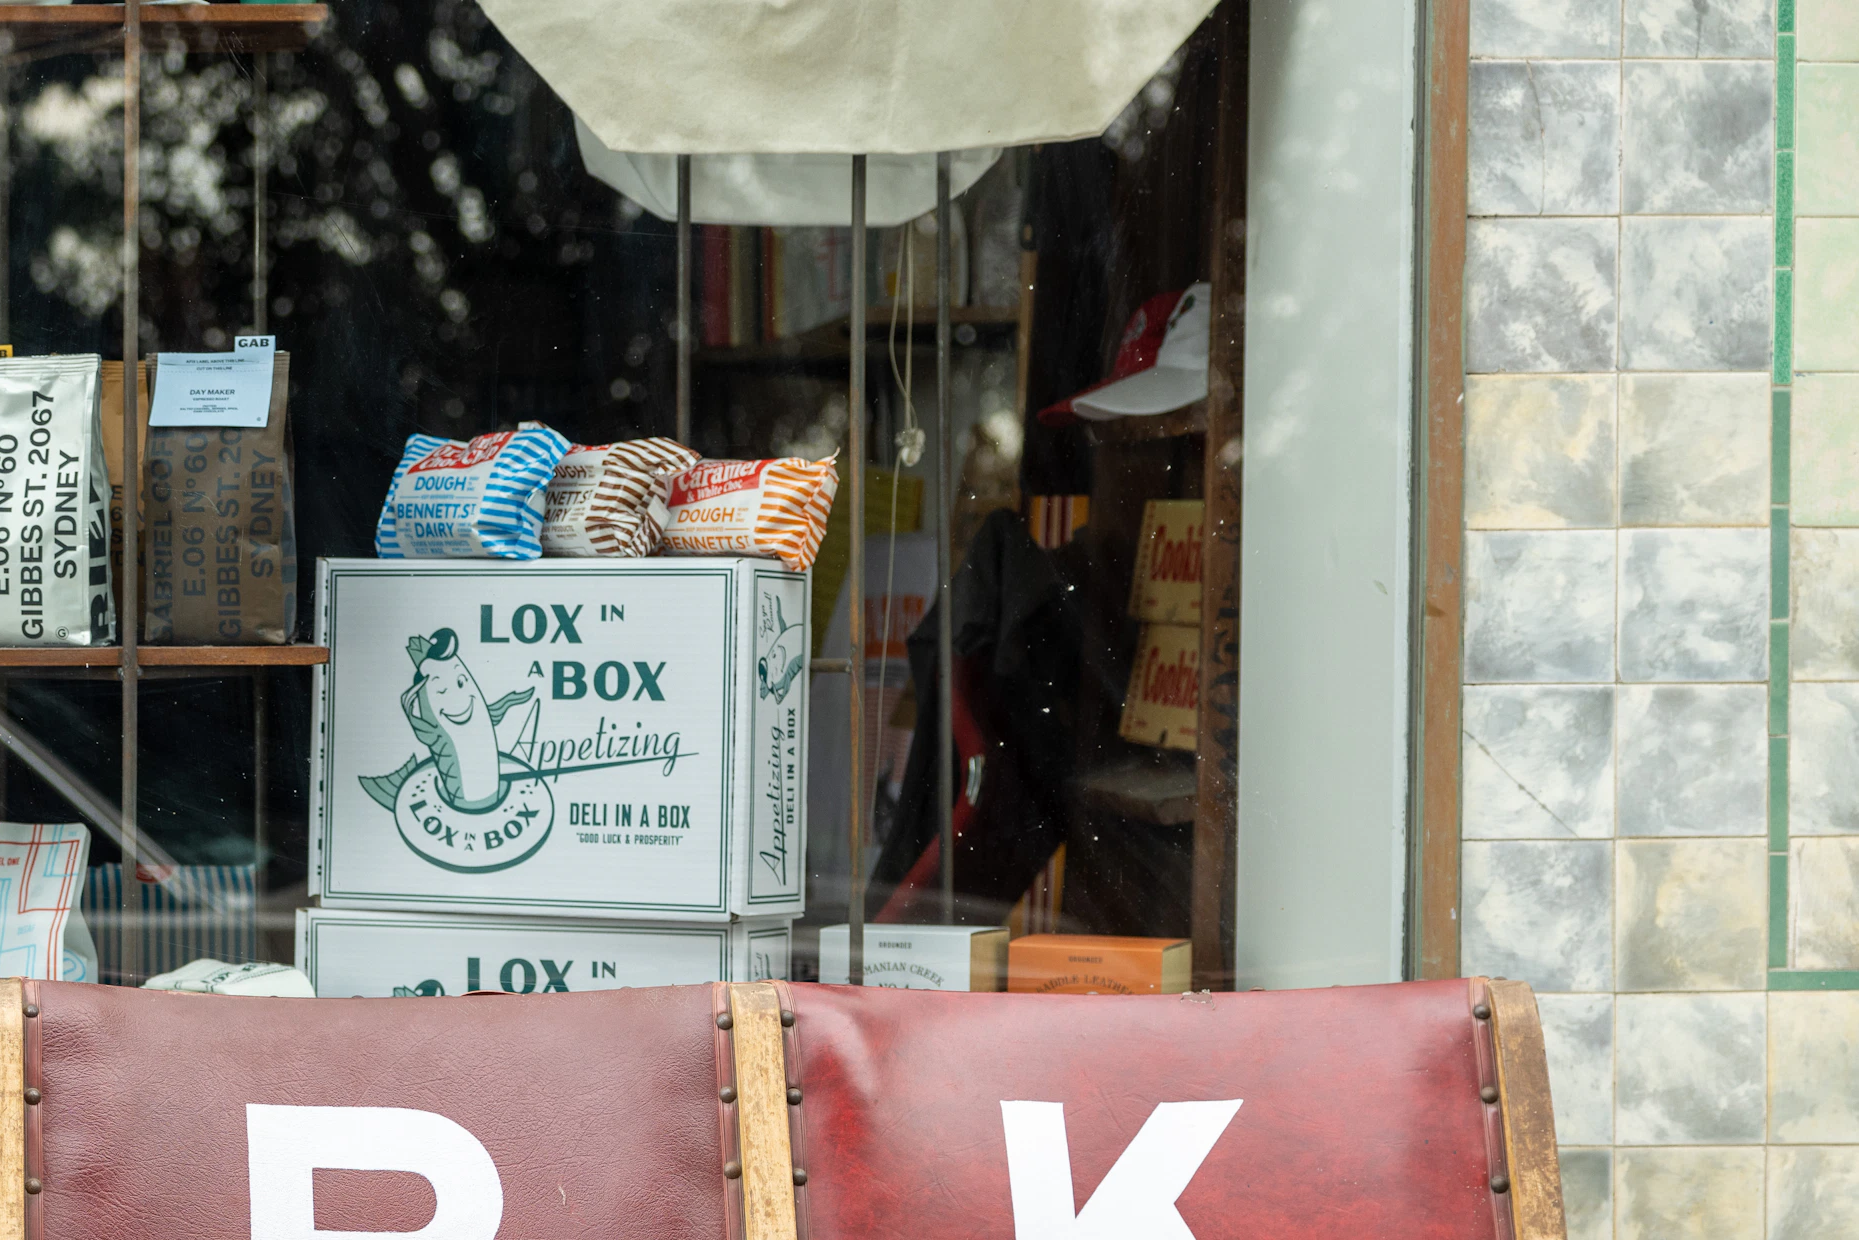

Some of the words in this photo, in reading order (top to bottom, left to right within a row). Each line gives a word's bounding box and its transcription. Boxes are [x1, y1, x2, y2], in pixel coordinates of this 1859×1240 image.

[238, 338, 270, 348] GAB
[28, 390, 54, 465] 2067
[414, 476, 466, 491] DOUGH
[678, 460, 757, 492] Caramel
[687, 491, 695, 503] &
[697, 484, 723, 500] White
[723, 479, 743, 492] Choc
[23, 473, 47, 518] ST.
[54, 450, 80, 580] SYDNEY
[250, 450, 277, 578] SYDNEY
[414, 522, 454, 538] DAIRY
[677, 507, 735, 523] DOUGH
[182, 526, 207, 597] E.06
[20, 525, 44, 640] GIBBES
[215, 525, 240, 640] GIBBES
[480, 604, 584, 644] LOX
[600, 604, 625, 622] IN
[527, 660, 545, 678] A
[551, 661, 667, 701] BOX
[788, 707, 796, 740] BOX
[510, 698, 681, 787] Appetizing
[787, 745, 795, 757] A
[787, 764, 795, 781] IN
[570, 803, 607, 827] DELI
[615, 804, 632, 828] IN
[639, 805, 651, 828] A
[658, 805, 691, 829] BOX
[759, 723, 786, 886] Appetizing
[786, 789, 795, 824] DELI
[408, 799, 460, 848] LOX
[464, 832, 476, 841] IN
[484, 802, 540, 851] BOX
[602, 833, 622, 845] LUCK
[625, 834, 631, 844] &
[7, 856, 21, 866] ONE
[463, 843, 474, 852] A
[17, 924, 36, 936] DECAF
[467, 957, 574, 994] LOX
[592, 961, 617, 980] IN
[910, 963, 945, 987] CREEK
[1036, 976, 1081, 993] SADDLE
